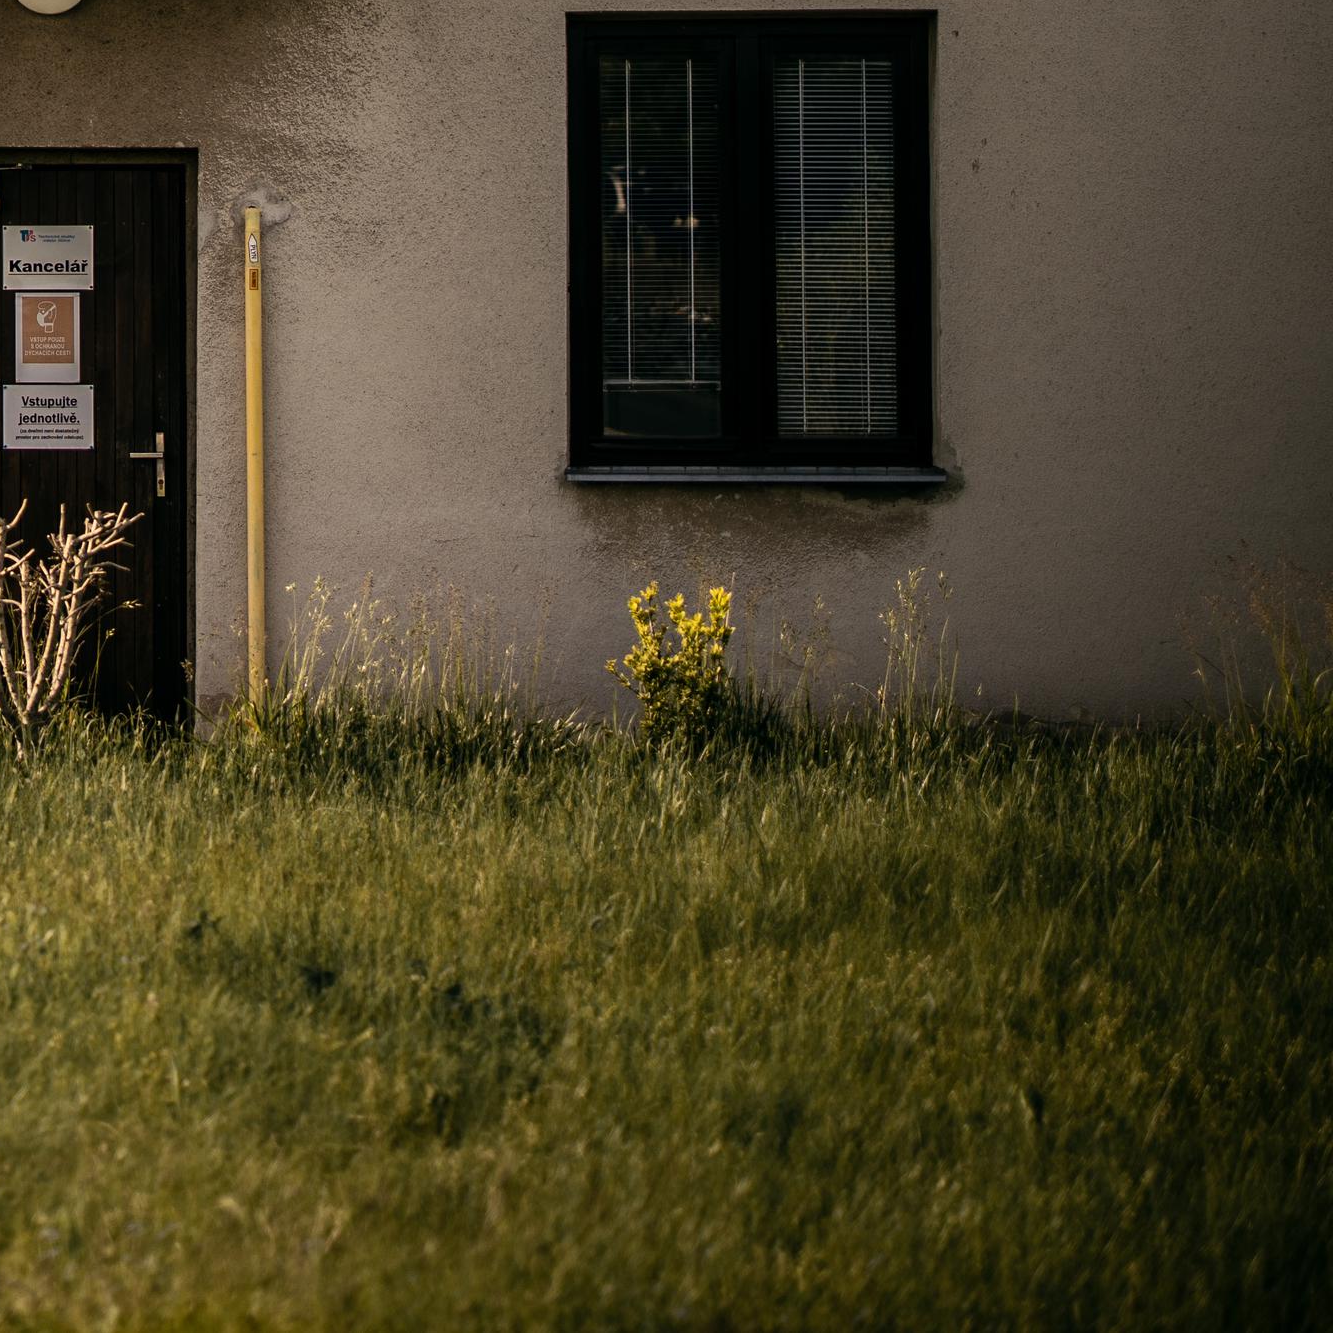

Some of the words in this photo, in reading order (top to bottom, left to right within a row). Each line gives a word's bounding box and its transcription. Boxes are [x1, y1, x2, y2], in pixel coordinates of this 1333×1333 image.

[9, 259, 88, 273] Kancelář
[21, 396, 78, 408] Vstupujte
[18, 412, 80, 425] jednotlivě.
